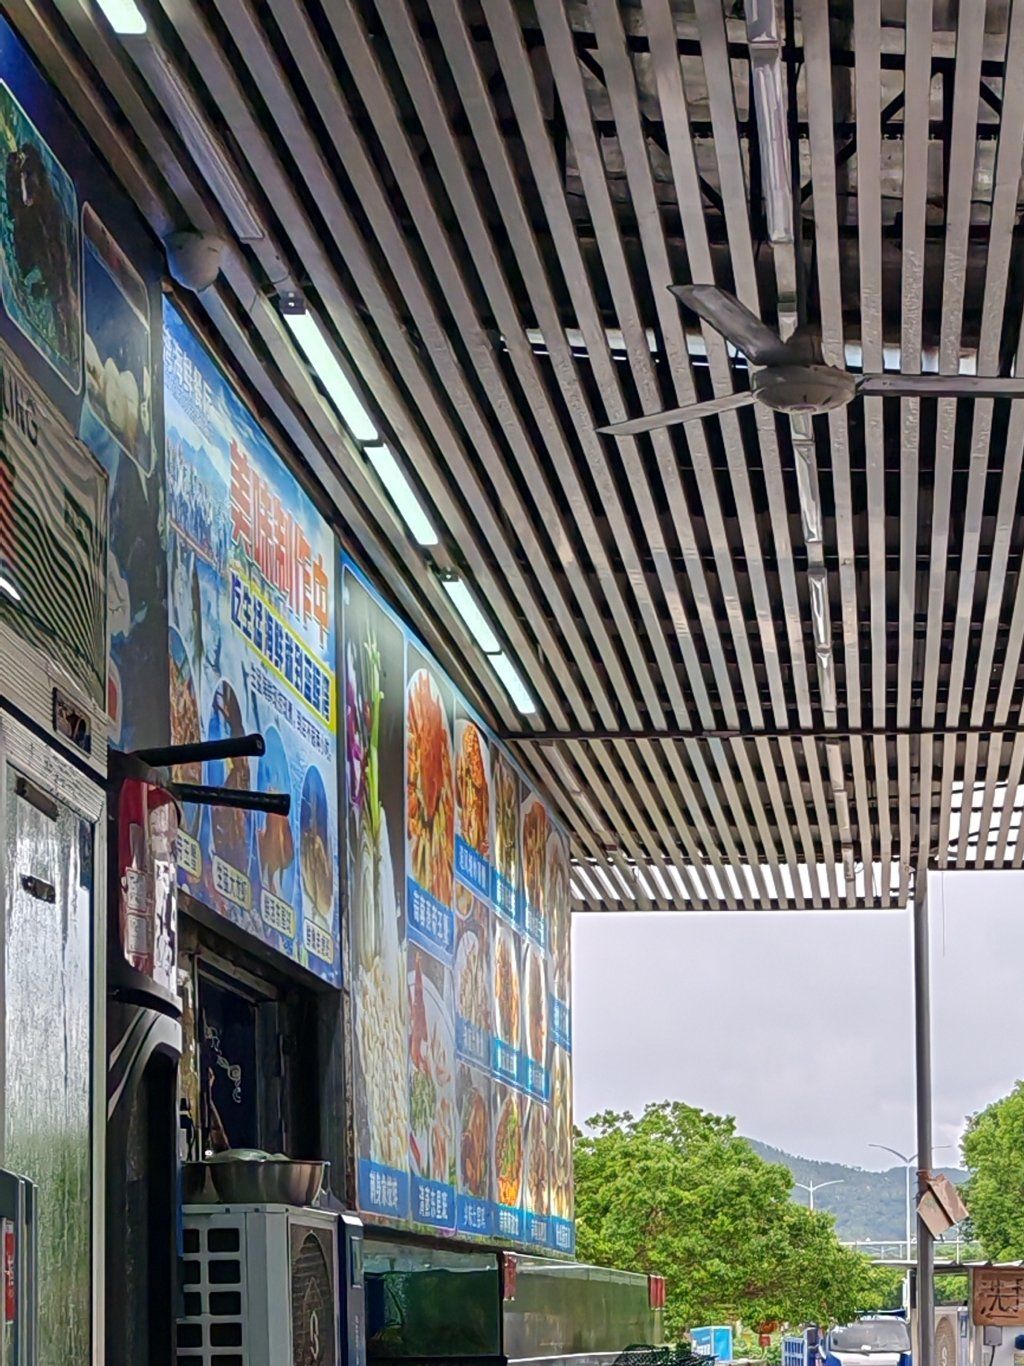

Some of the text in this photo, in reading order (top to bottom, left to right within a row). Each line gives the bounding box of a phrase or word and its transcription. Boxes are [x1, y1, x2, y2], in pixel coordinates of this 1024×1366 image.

[230, 438, 330, 650] 美味制作中
